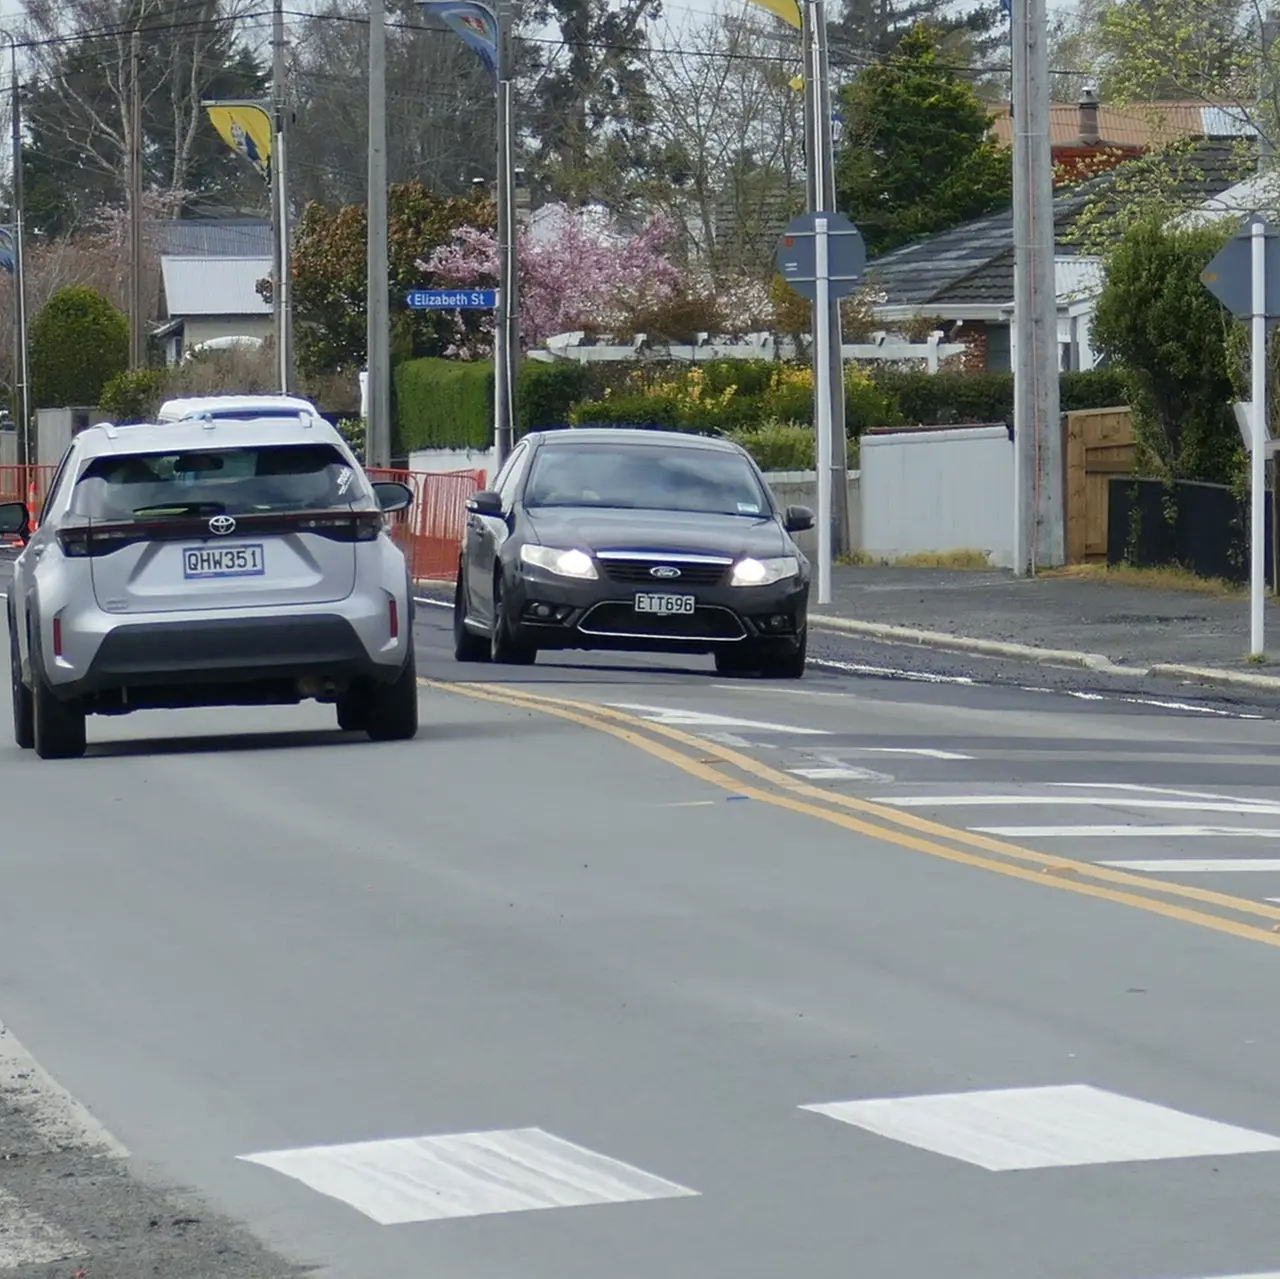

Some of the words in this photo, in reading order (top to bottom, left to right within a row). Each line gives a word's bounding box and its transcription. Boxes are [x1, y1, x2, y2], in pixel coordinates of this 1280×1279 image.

[414, 293, 468, 306] Elizabeth
[471, 293, 485, 306] St
[187, 550, 258, 571] QHW351
[637, 595, 693, 612] ETT696
